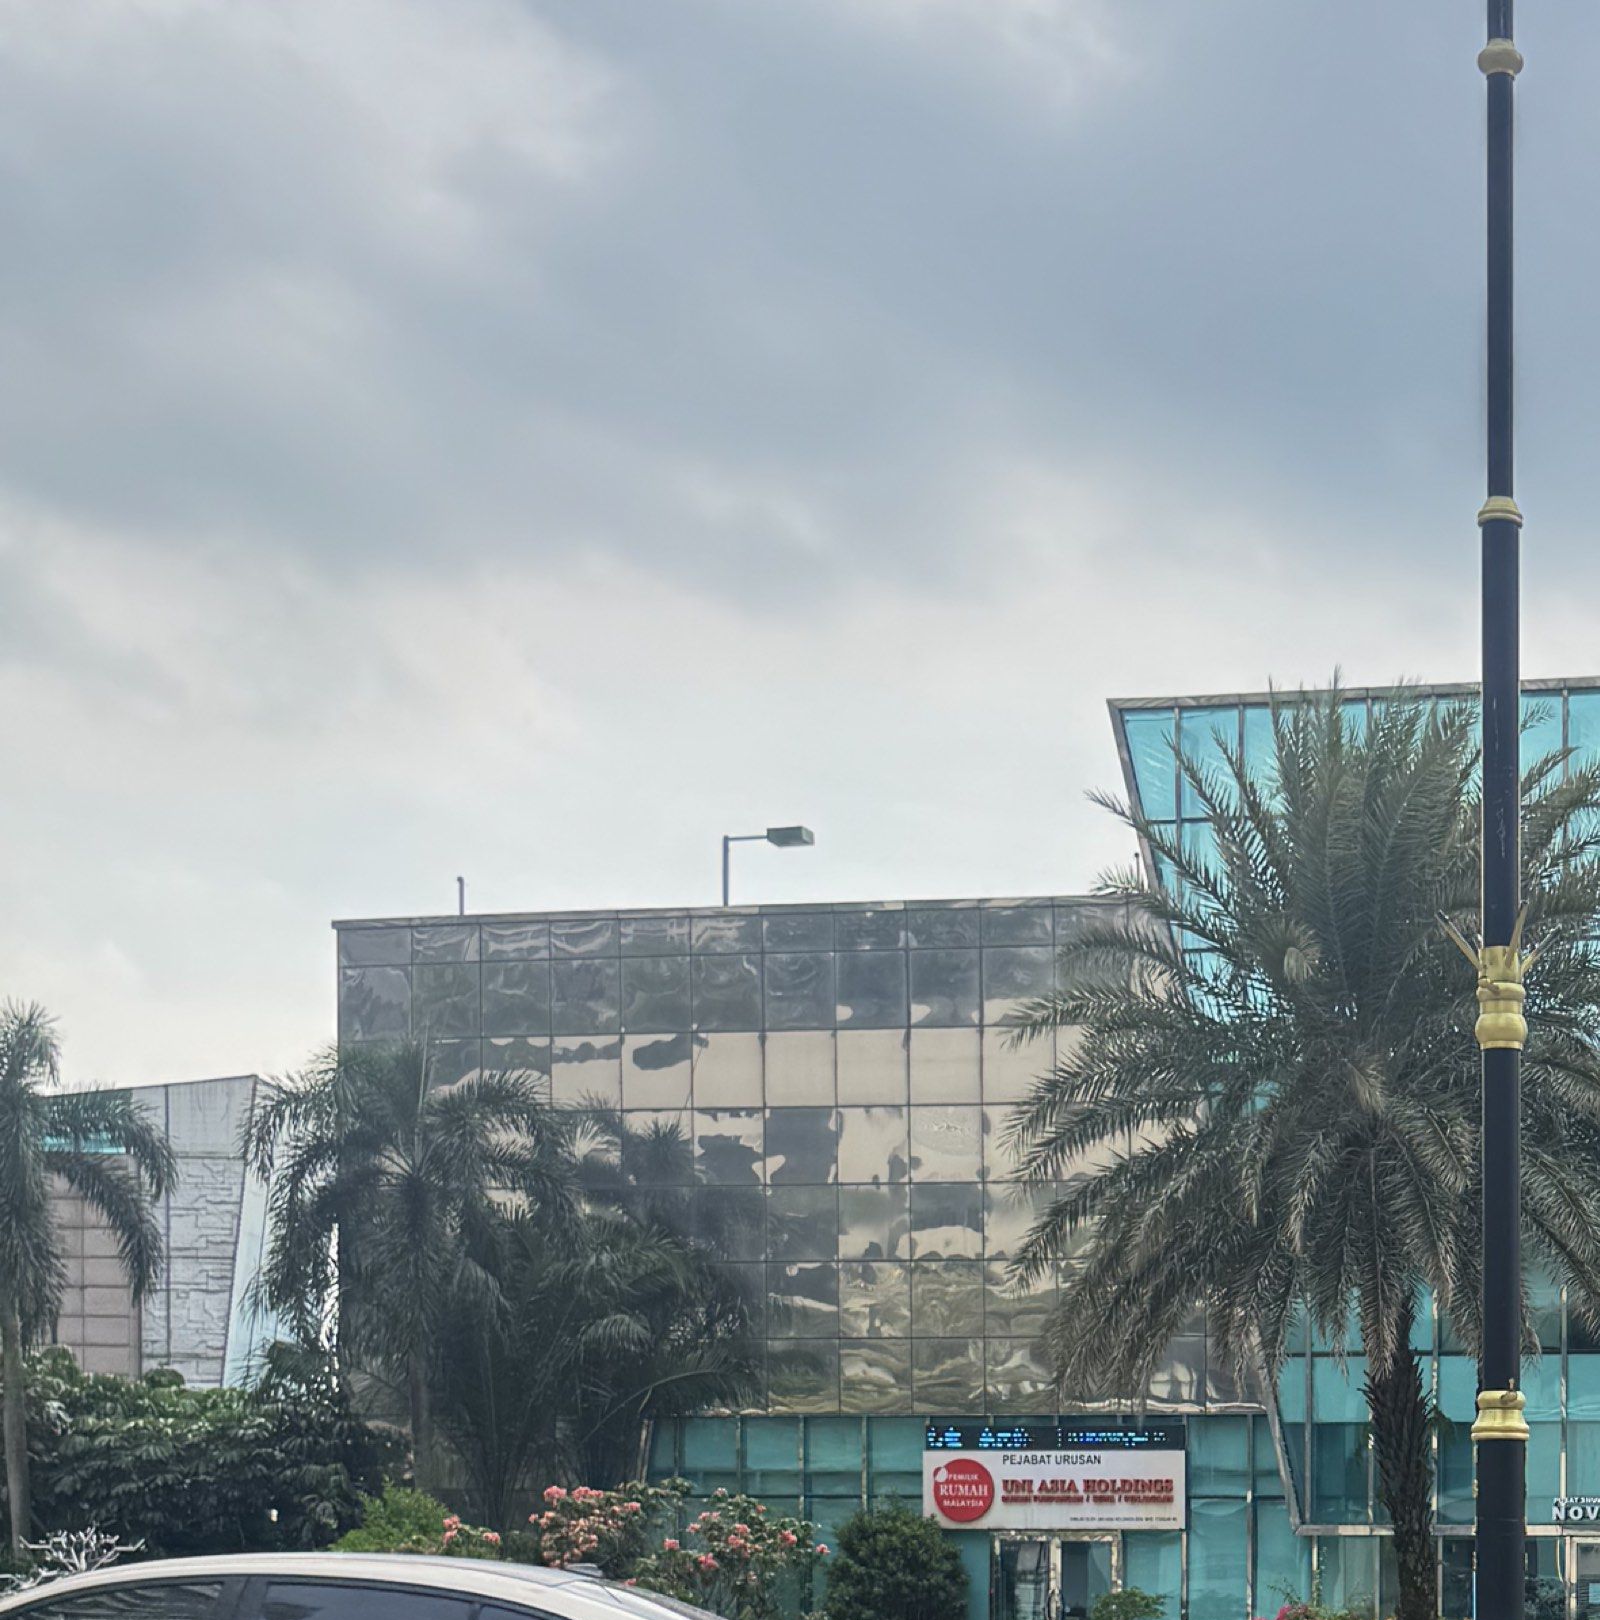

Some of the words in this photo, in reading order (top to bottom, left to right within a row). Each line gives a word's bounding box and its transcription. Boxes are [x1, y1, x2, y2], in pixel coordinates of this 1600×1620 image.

[1002, 1454, 1051, 1465] PEJABAT
[1055, 1454, 1101, 1465] URUSAN
[940, 1484, 988, 1496] RUMAH
[1002, 1479, 1033, 1493] UNI
[1037, 1479, 1079, 1493] ASIA
[1083, 1479, 1174, 1494] HOLDINGS
[943, 1499, 984, 1507] MALAYSIA
